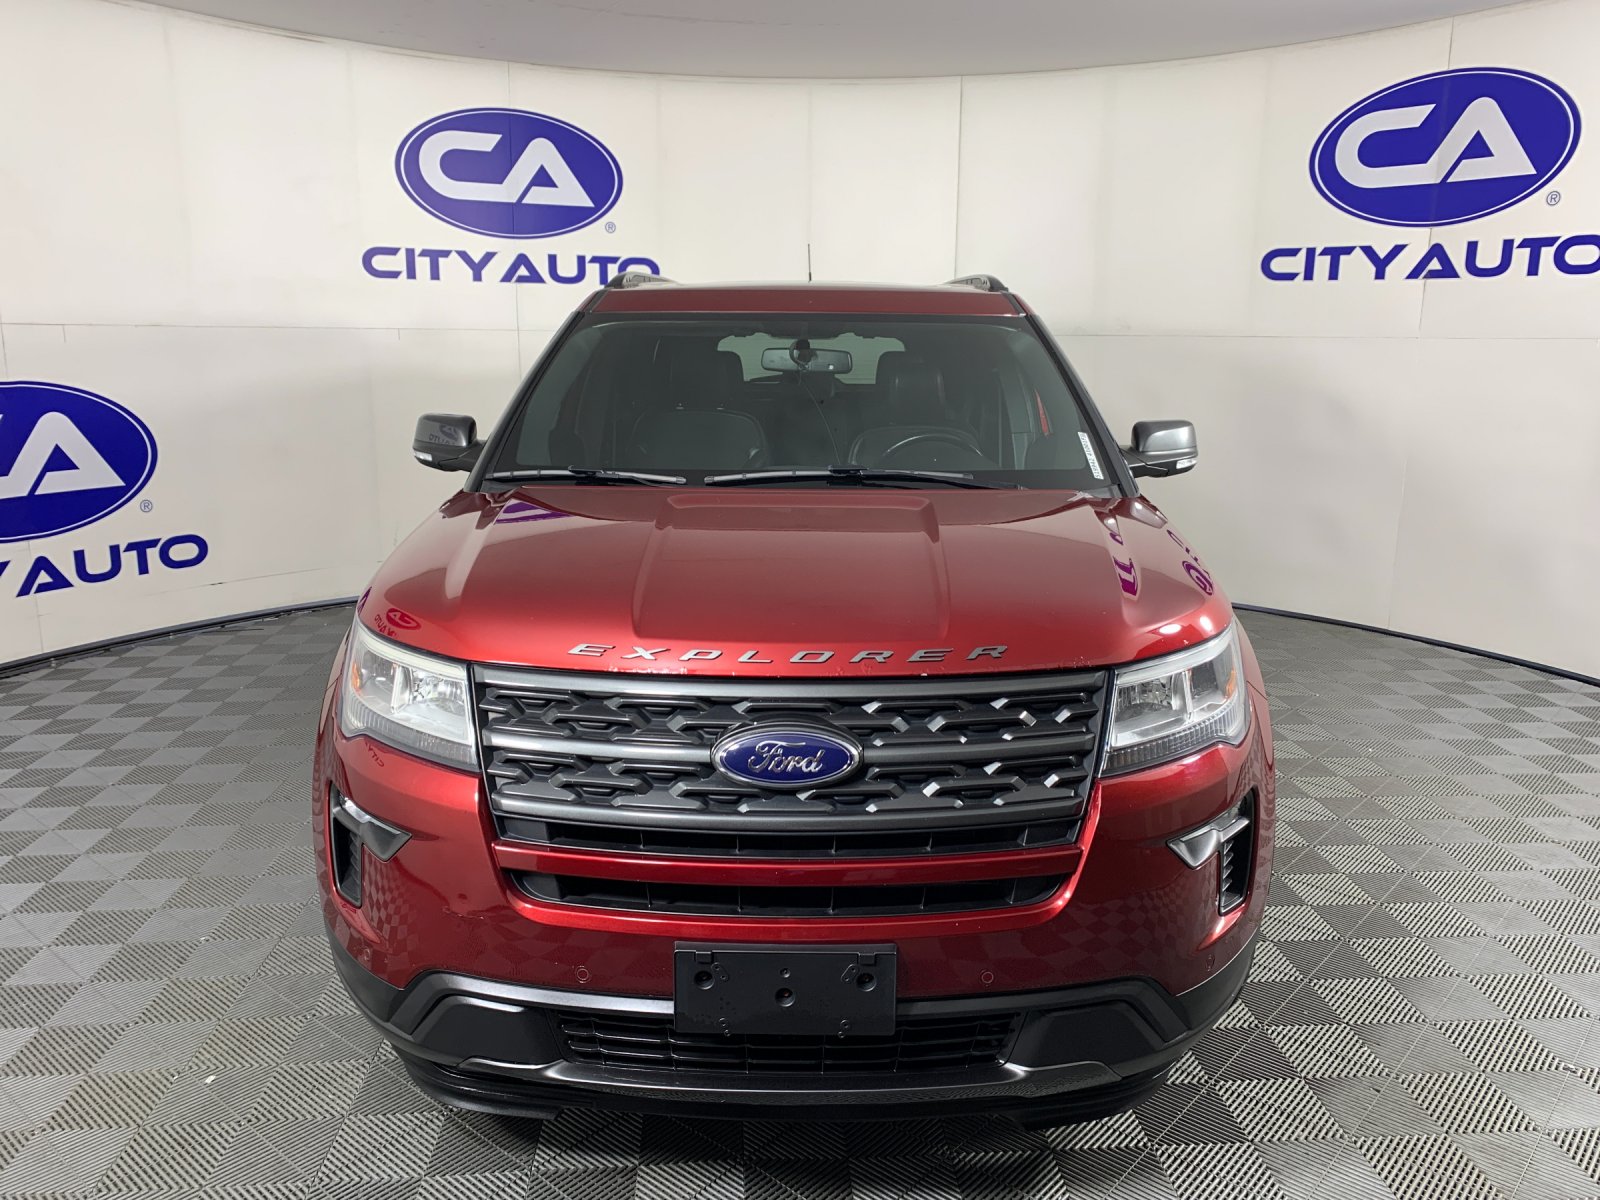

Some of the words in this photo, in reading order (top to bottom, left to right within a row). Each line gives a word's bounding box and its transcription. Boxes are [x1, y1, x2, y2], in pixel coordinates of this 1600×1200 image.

[419, 130, 595, 207] CA
[1335, 96, 1537, 189] CA
[362, 246, 498, 282] CITY
[1261, 243, 1409, 281] CITY
[1404, 234, 1600, 280] AUTO
[0, 411, 126, 500] A
[16, 534, 208, 598] AUTO
[568, 643, 1008, 664] EXPLORER
[748, 740, 825, 772] Ford
